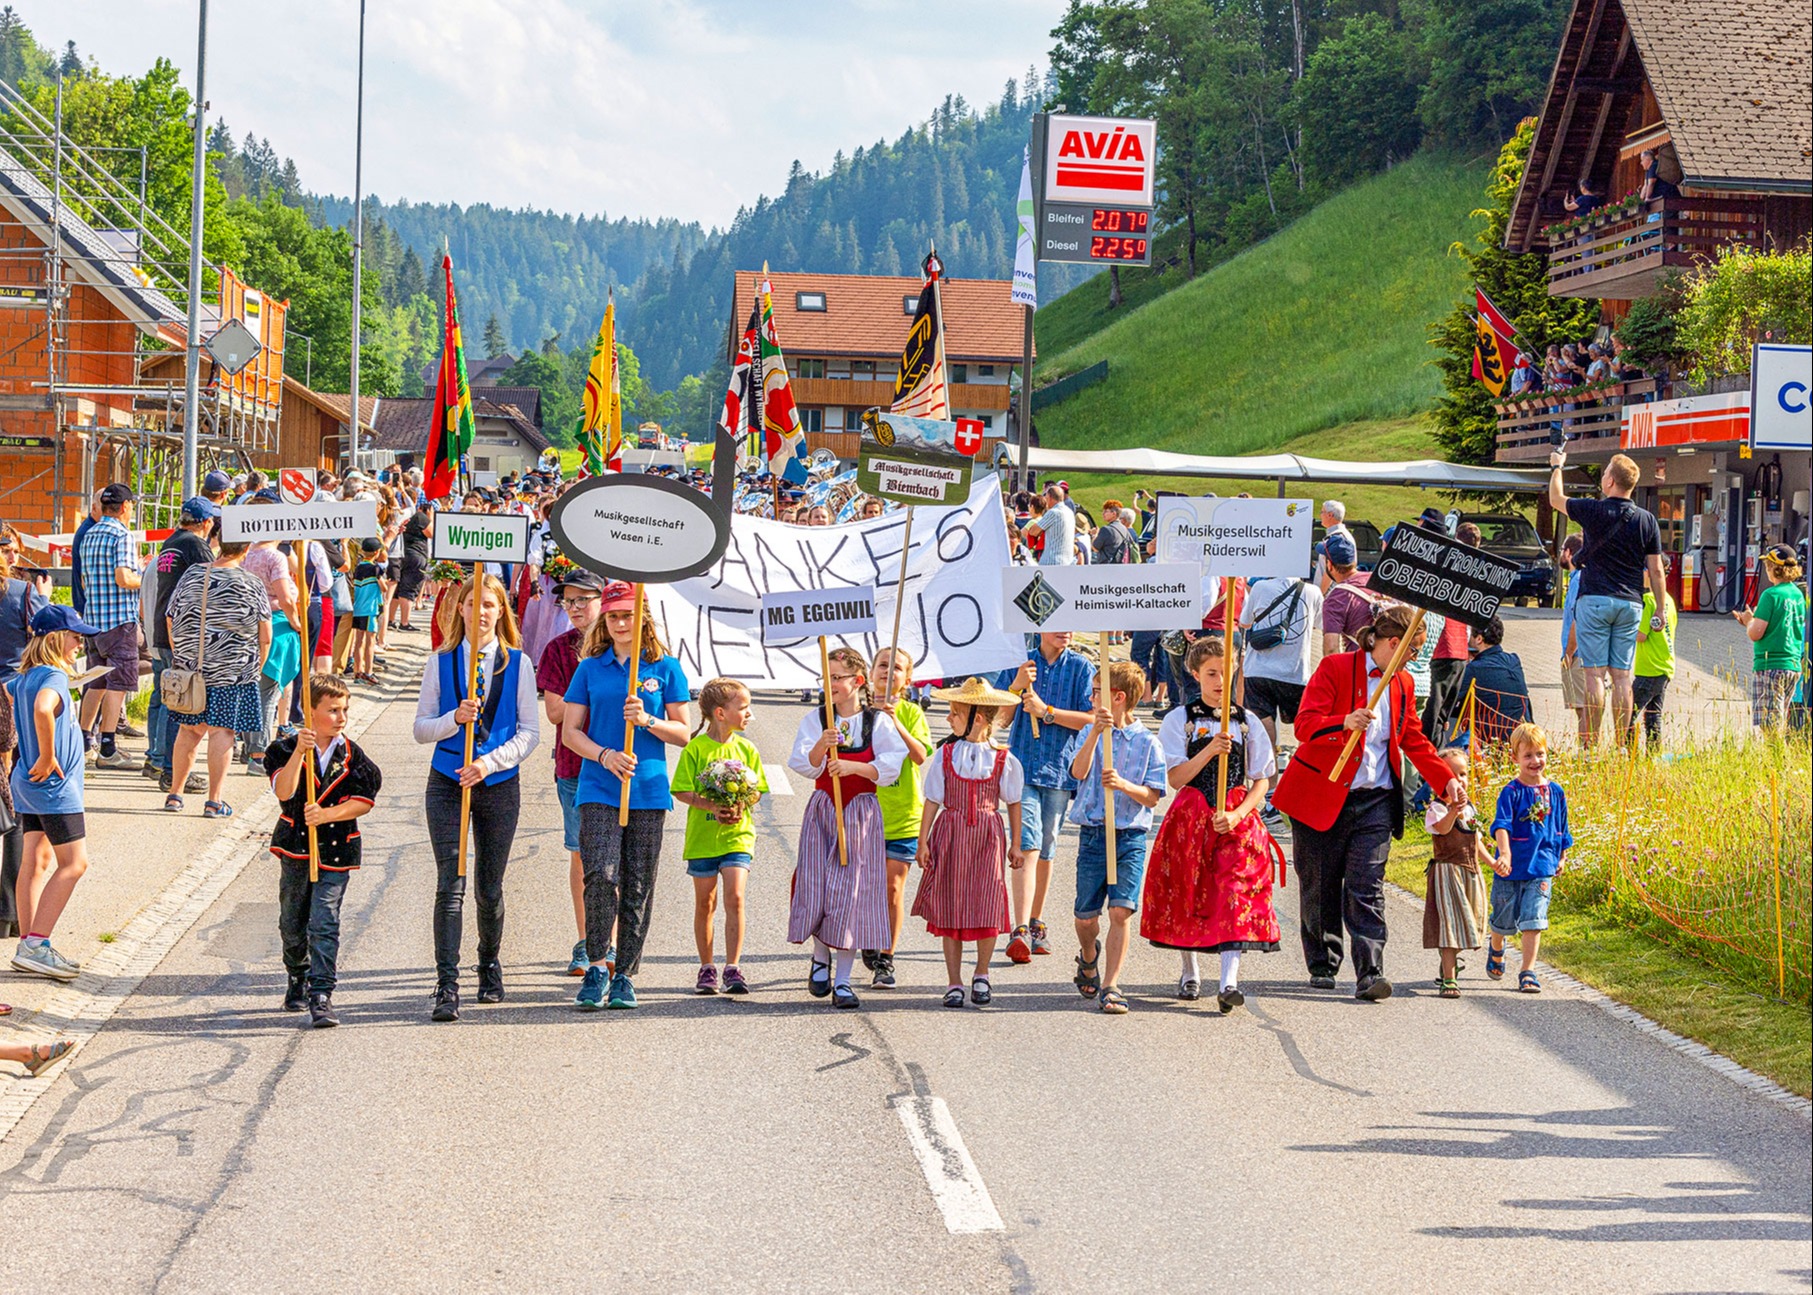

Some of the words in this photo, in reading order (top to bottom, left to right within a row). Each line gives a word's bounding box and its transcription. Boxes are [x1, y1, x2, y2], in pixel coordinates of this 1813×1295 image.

[1048, 212, 1085, 225] Bleifrei
[1046, 239, 1079, 251] Diesel
[1777, 381, 1813, 414] C
[874, 462, 955, 481] Musikgesellschaft
[886, 478, 940, 498] Biembach
[594, 509, 685, 530] Musikgesellschaft
[448, 525, 513, 551] Wynigen
[610, 530, 643, 543] Wasen
[647, 534, 664, 546] i.E.
[1178, 524, 1293, 540] Musikgesellschaft
[1203, 543, 1266, 557] Rüderswil
[1392, 528, 1445, 564] MUSIK
[1442, 547, 1518, 590] FROHSINN
[1079, 583, 1186, 596] Musikgesellschaft
[1378, 558, 1499, 618] OBERBURG
[768, 605, 795, 626] MG
[802, 600, 874, 623] EGGIWIL
[1074, 598, 1192, 610] Heimiswil-Kaltacker
